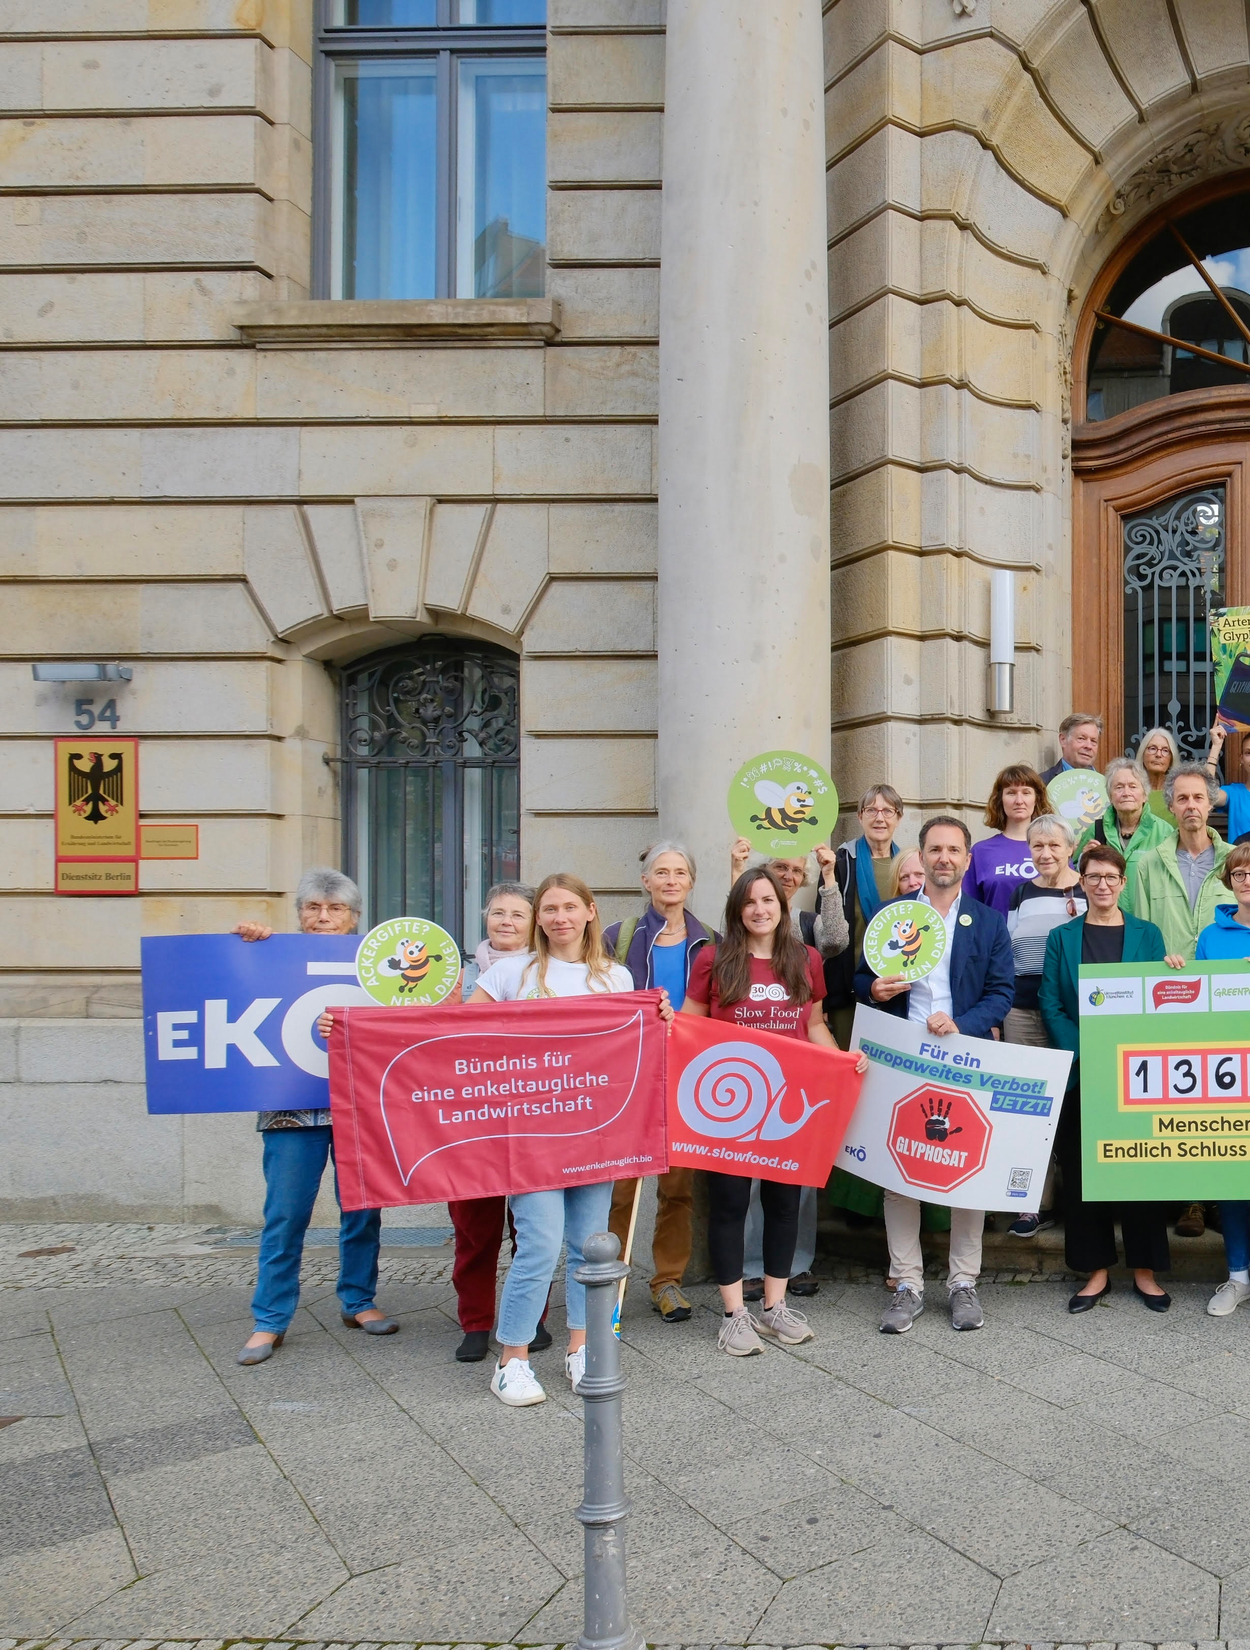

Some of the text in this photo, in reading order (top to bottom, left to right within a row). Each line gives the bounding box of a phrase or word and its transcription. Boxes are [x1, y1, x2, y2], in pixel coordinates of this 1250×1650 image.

[74, 698, 121, 731] 54
[61, 872, 132, 881] Dienstsitz Berlin
[867, 903, 914, 971] ACKERGIFTE?
[924, 910, 945, 959] DANKE!
[360, 921, 431, 987] ACKERGIFTE?
[434, 939, 458, 996] DANKE!
[751, 986, 765, 994] 30
[734, 1006, 766, 1019] Slow
[455, 1051, 572, 1075] Bündnis für
[860, 1043, 1045, 1094] europaweites Verbot!
[919, 1042, 981, 1069] Für ein
[411, 1072, 609, 1103] eine enkeltaugliche
[438, 1095, 593, 1125] Landwirtschaft
[992, 1094, 1052, 1113] JETZT!
[562, 1154, 653, 1174] www.enkeltauglich.bio
[671, 1141, 800, 1172] www.slowfood.de
[895, 1135, 968, 1168] GLYPHOSAT
[1103, 1141, 1172, 1159] Endlich
[1176, 1140, 1248, 1158] Schluss
